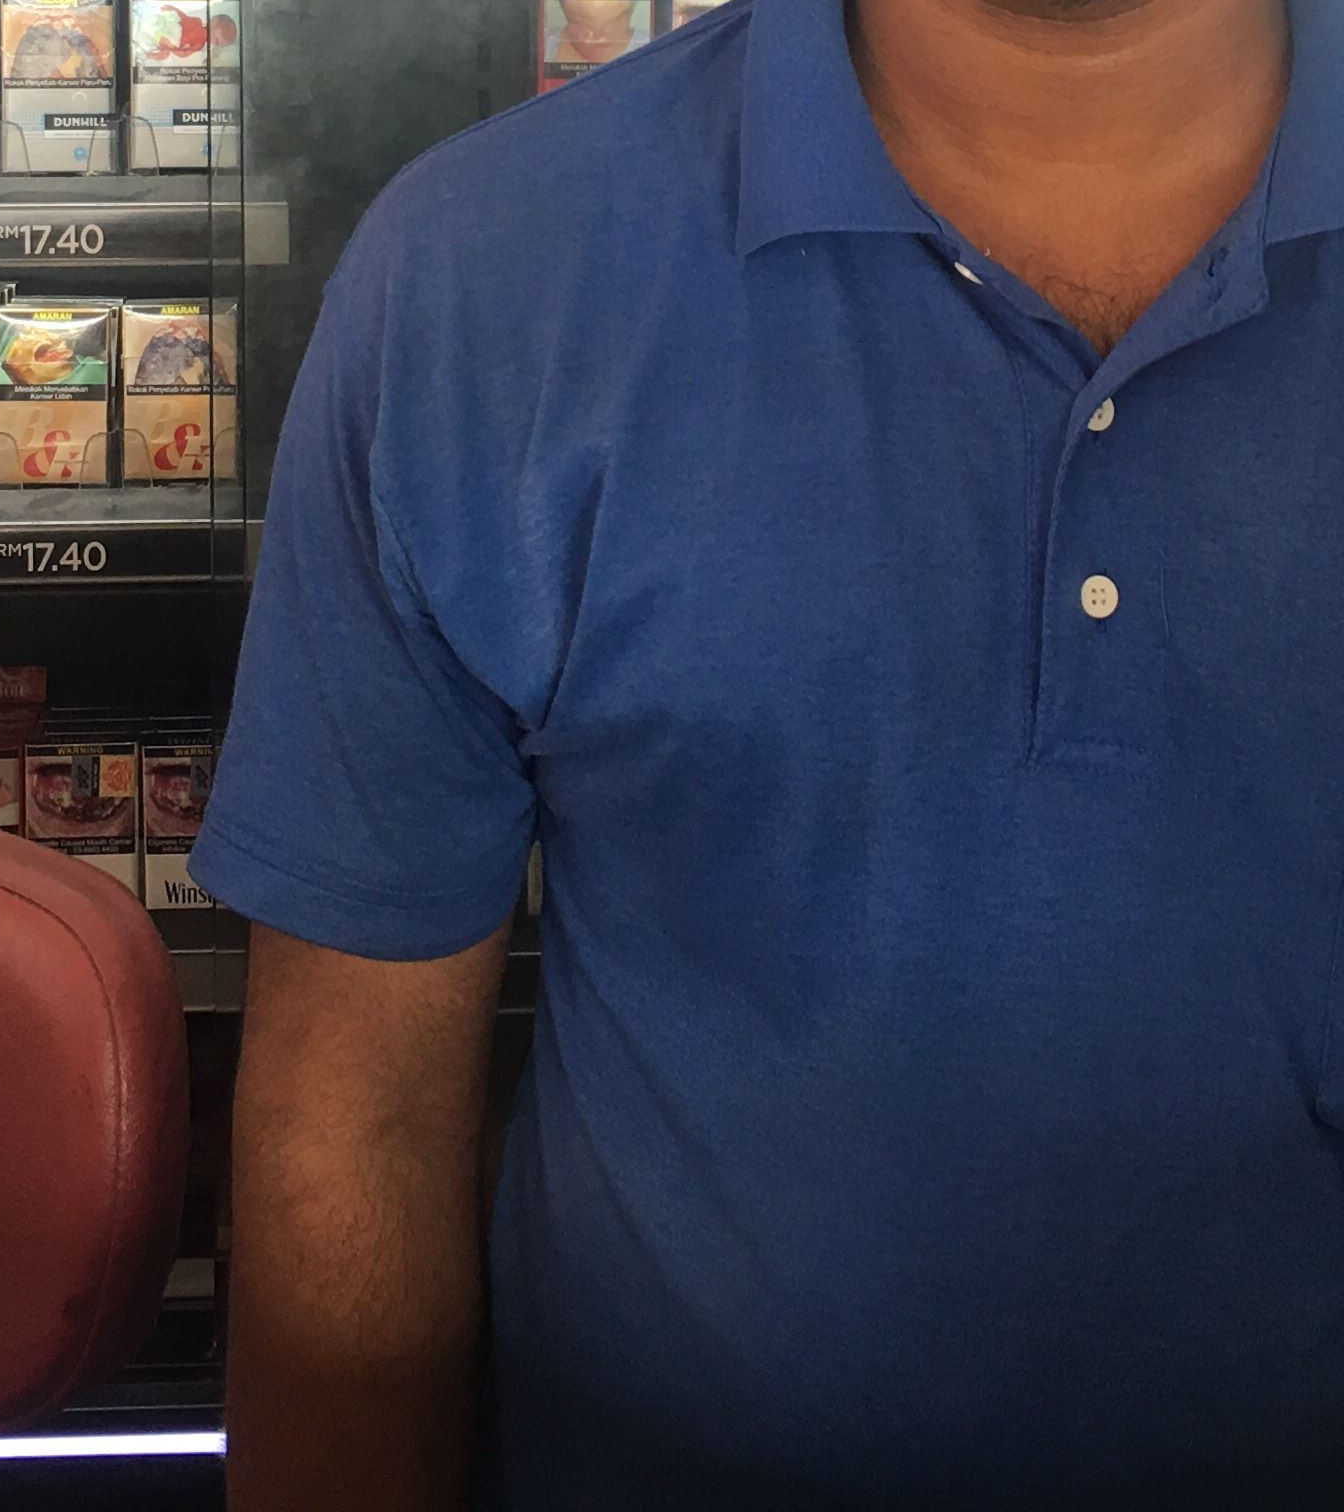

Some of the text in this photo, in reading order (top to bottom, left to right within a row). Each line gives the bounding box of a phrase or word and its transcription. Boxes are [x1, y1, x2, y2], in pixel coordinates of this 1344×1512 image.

[54, 117, 107, 127] DUNHILL
[33, 312, 72, 320] AMARAN
[58, 747, 104, 755] WARNING
[175, 748, 213, 756] WARNIN
